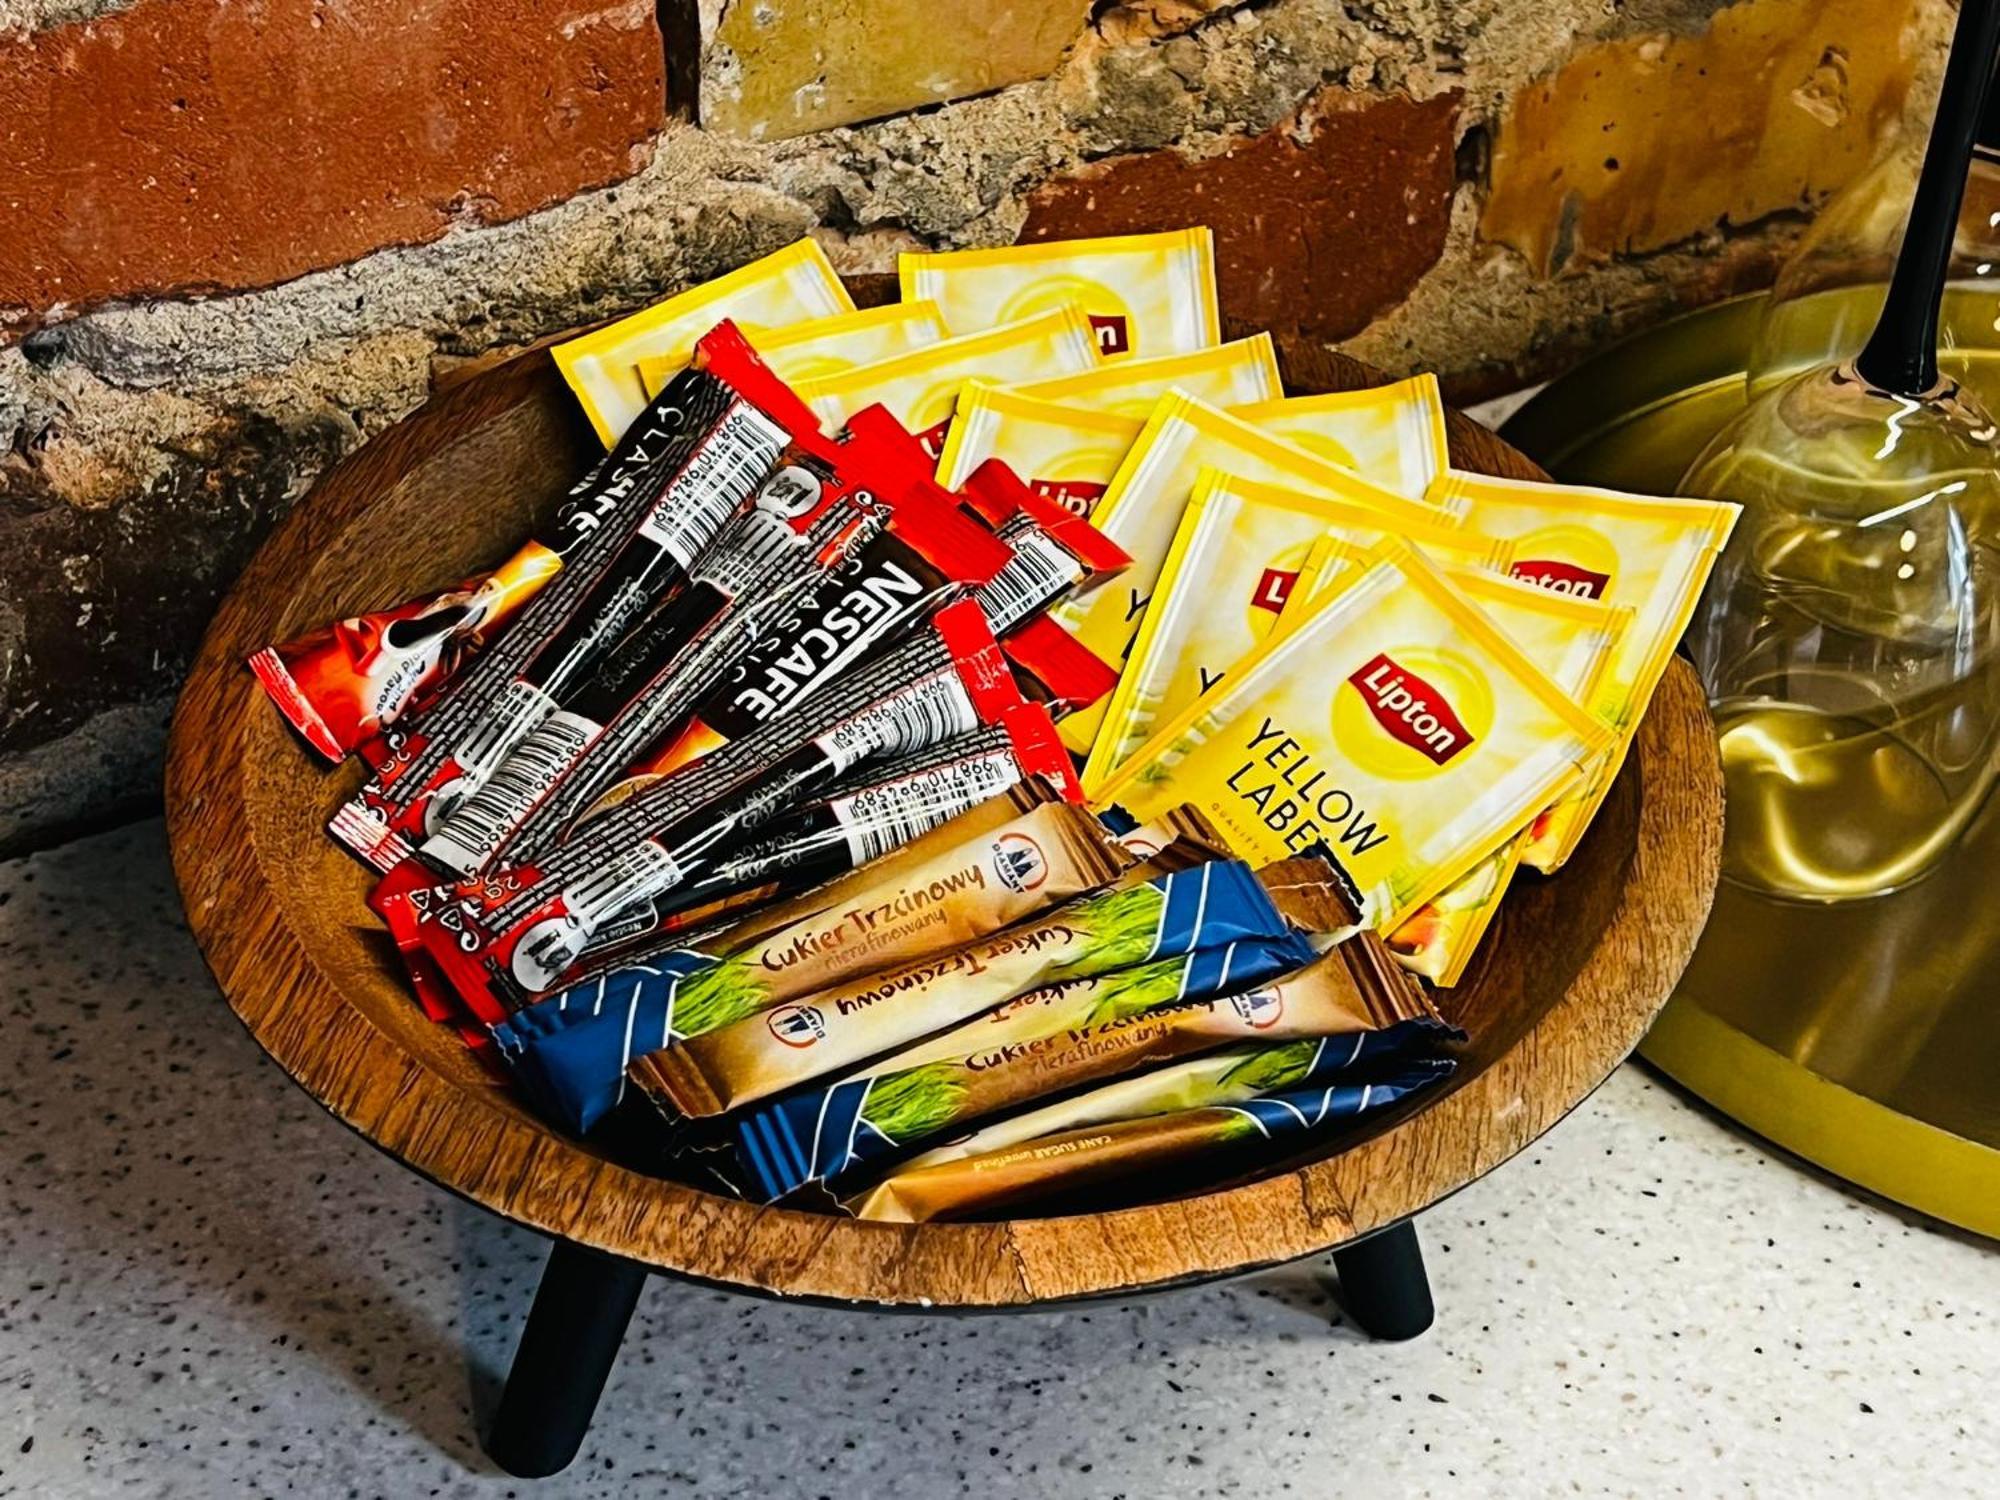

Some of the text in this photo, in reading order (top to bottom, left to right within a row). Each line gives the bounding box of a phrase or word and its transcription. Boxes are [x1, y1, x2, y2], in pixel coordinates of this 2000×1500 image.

[834, 708, 893, 742] 984589
[1362, 663, 1457, 754] Lipton
[479, 794, 535, 855] 998710
[533, 737, 588, 793] 984589
[927, 757, 994, 788] 998710
[1246, 716, 1389, 856] YELLOW
[1225, 760, 1330, 852] LABE
[761, 920, 845, 972] Cukier
[843, 863, 985, 934] Trzcinowy
[824, 905, 949, 971] nierafinowany
[985, 925, 1074, 961] Cukier
[835, 949, 988, 1016] Trzcinowy
[964, 1034, 1056, 1073] Cukier
[1034, 1141, 1078, 1161] SUGAR
